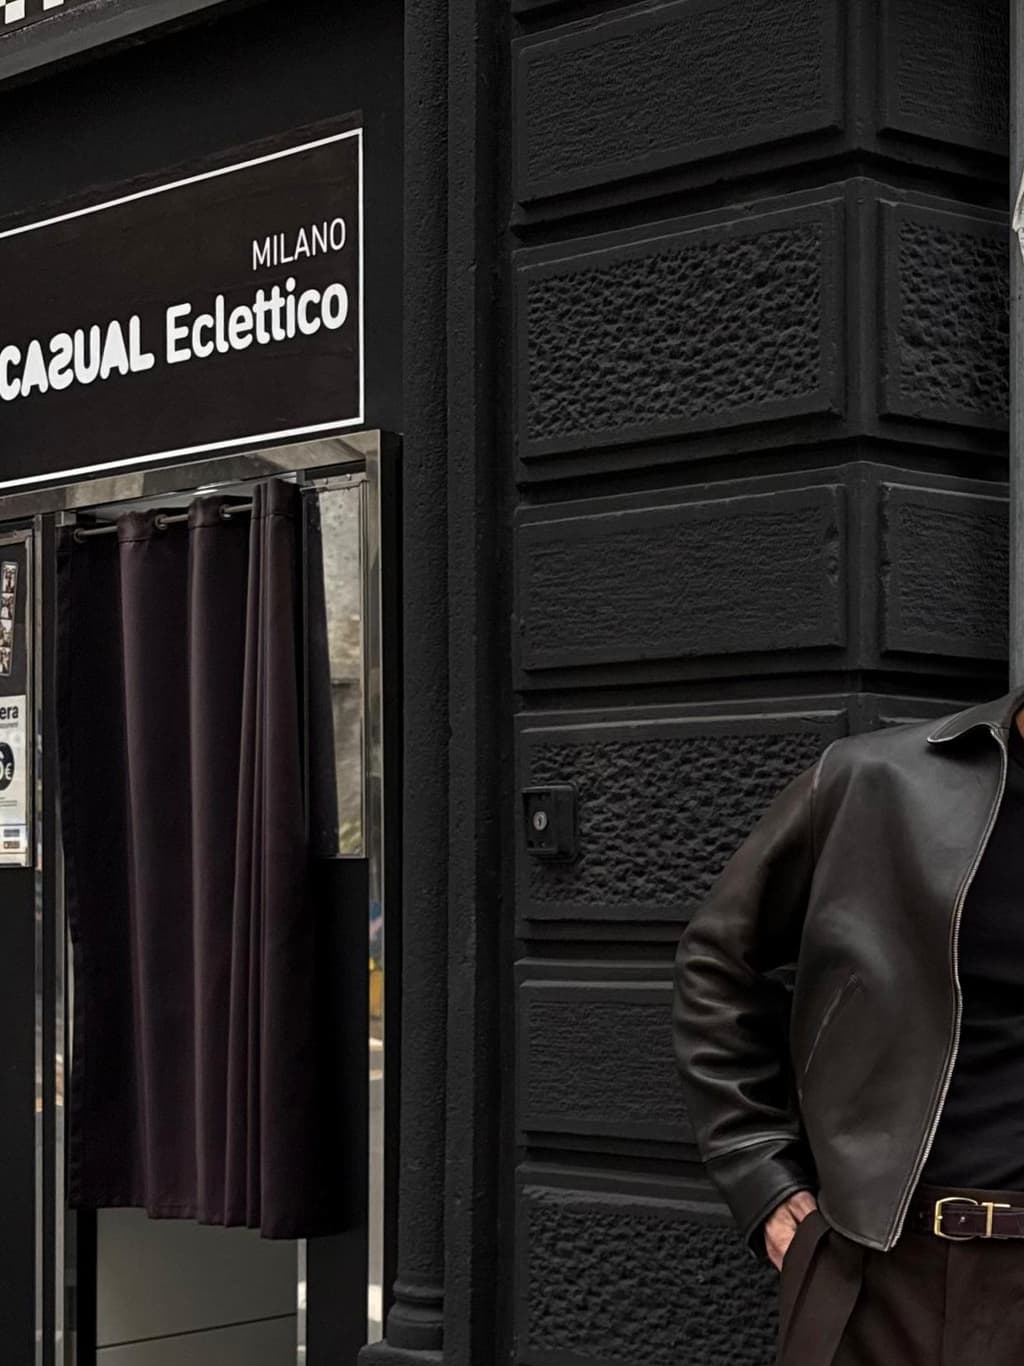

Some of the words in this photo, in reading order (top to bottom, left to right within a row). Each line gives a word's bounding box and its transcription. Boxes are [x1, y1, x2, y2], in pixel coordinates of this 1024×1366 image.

[253, 217, 346, 271] MILANO
[0, 315, 155, 401] CASUAL
[166, 277, 349, 364] Eclettico
